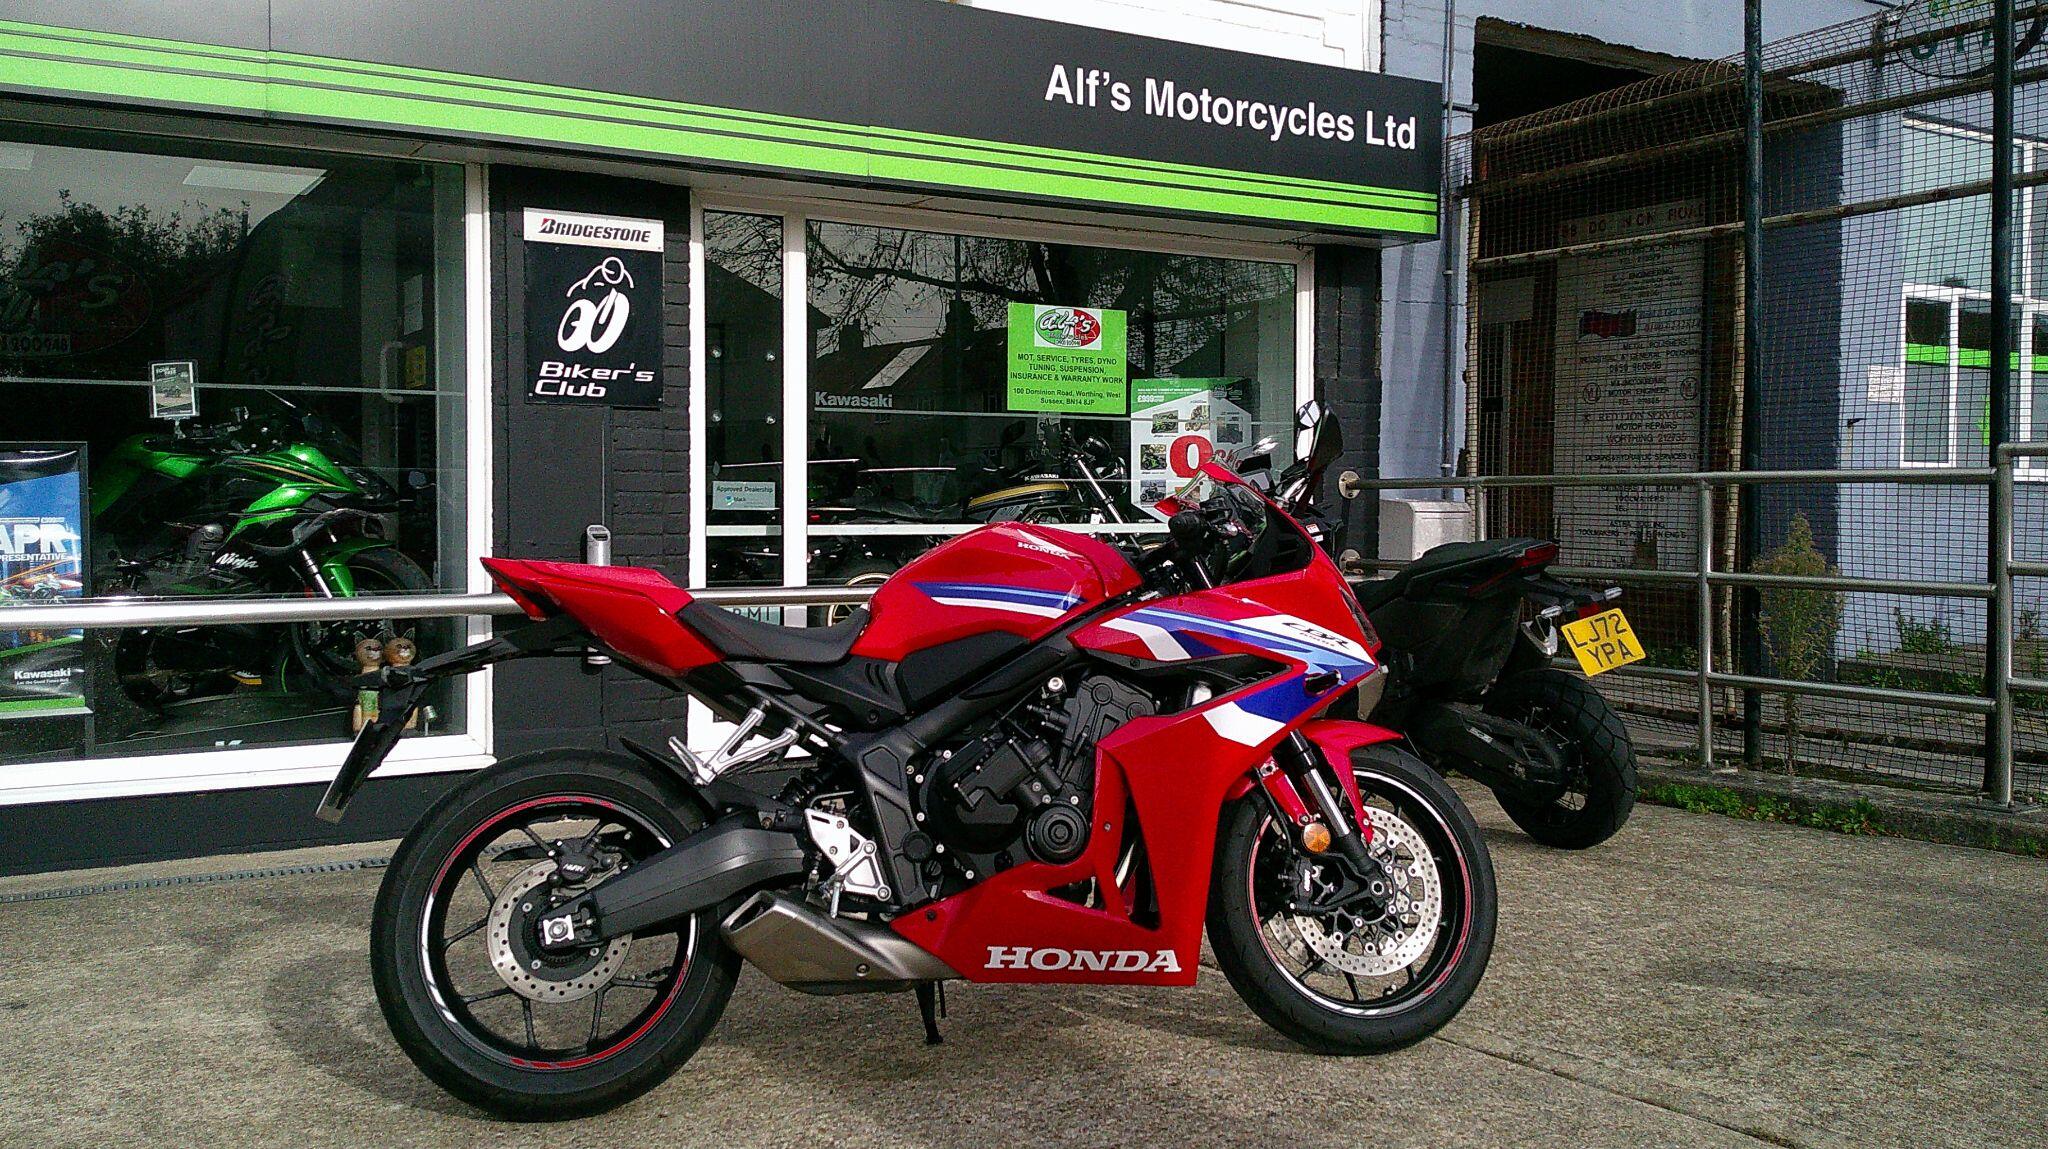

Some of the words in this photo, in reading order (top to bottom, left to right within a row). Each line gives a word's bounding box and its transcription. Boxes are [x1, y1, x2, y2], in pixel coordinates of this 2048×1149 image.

[1045, 64, 1132, 112] Alf's
[1145, 78, 1354, 141] Motorcycles
[1366, 110, 1416, 150] Ltd
[539, 218, 651, 243] BRIDGESTONE
[1017, 353, 1035, 362] MOT,
[1036, 354, 1069, 363] SERVICE,
[1071, 356, 1096, 365] TYRES,
[1097, 357, 1117, 365] DYNO
[539, 361, 655, 382] Biker's
[1010, 372, 1052, 380] INSURANCE
[1061, 375, 1100, 383] WARRANTY
[1102, 376, 1123, 384] WORK
[1029, 364, 1057, 372] TUNING,
[1060, 365, 1106, 374] SUSPENSION,
[534, 379, 607, 398] Club
[1025, 388, 1055, 396] Dominion
[1056, 389, 1074, 397] Road,
[1076, 390, 1105, 399] Worthing,
[815, 391, 893, 408] Kawasaki
[1645, 421, 1678, 430] REPAIRS
[1606, 434, 1654, 444] WORTHING
[1017, 541, 1071, 560] HONDA
[215, 552, 259, 570] Ninja
[1567, 613, 1627, 648] LJ72
[1587, 639, 1636, 668] YPA
[14, 667, 71, 680] Kawasaki
[984, 946, 1182, 973] HONDA
